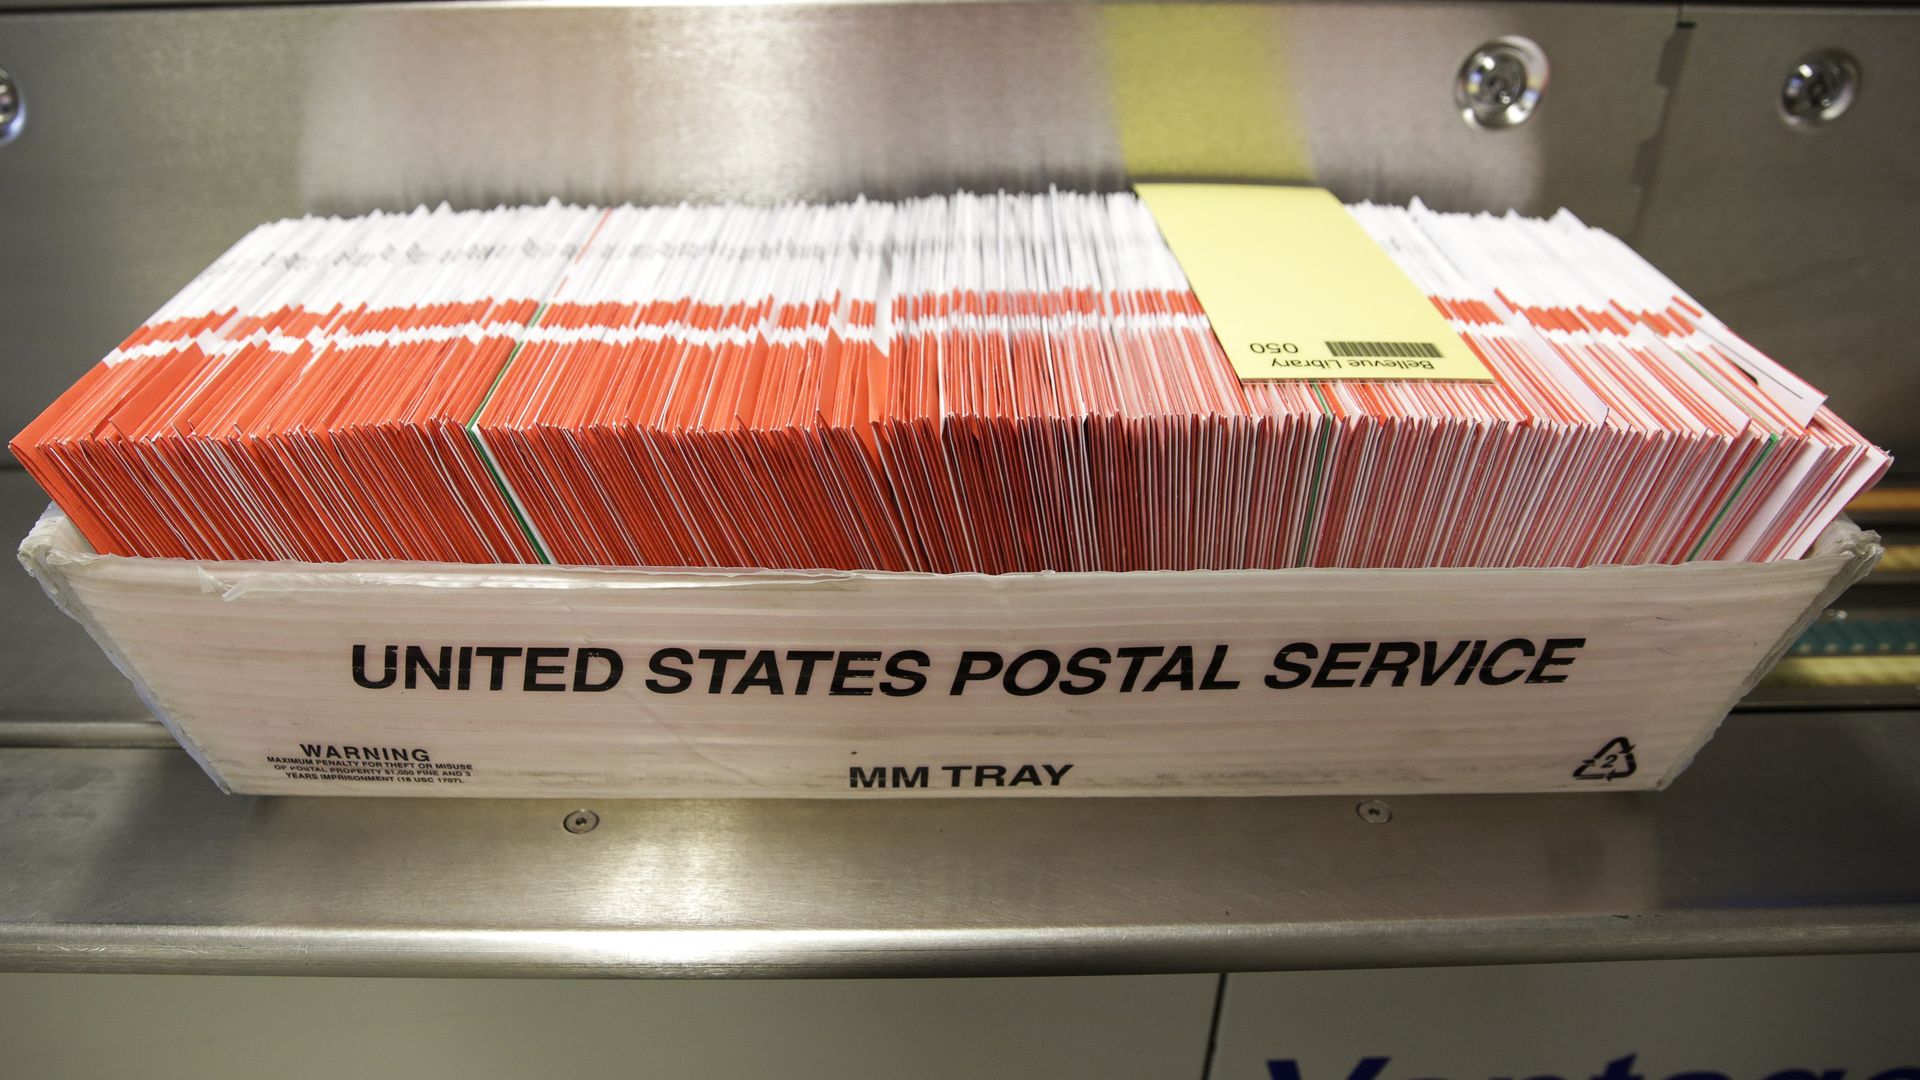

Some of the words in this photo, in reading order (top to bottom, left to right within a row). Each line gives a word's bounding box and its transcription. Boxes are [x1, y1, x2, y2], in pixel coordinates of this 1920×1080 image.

[1250, 343, 1299, 353] 050
[1271, 357, 1342, 369] Library
[1349, 358, 1434, 370] Bellevue
[351, 644, 623, 692] UNITED
[645, 647, 930, 697] STATES
[950, 644, 1241, 696] POSTAL
[1264, 638, 1586, 689] SERVICE
[299, 743, 430, 762] WARNING
[266, 756, 313, 764] MAXIMUM
[315, 759, 358, 767] PENALTY
[1601, 754, 1618, 768] 2
[285, 771, 318, 780] YEARS
[320, 774, 395, 782] IMPRISONMENT
[849, 765, 929, 788] MM
[941, 764, 1074, 787] TRAY
